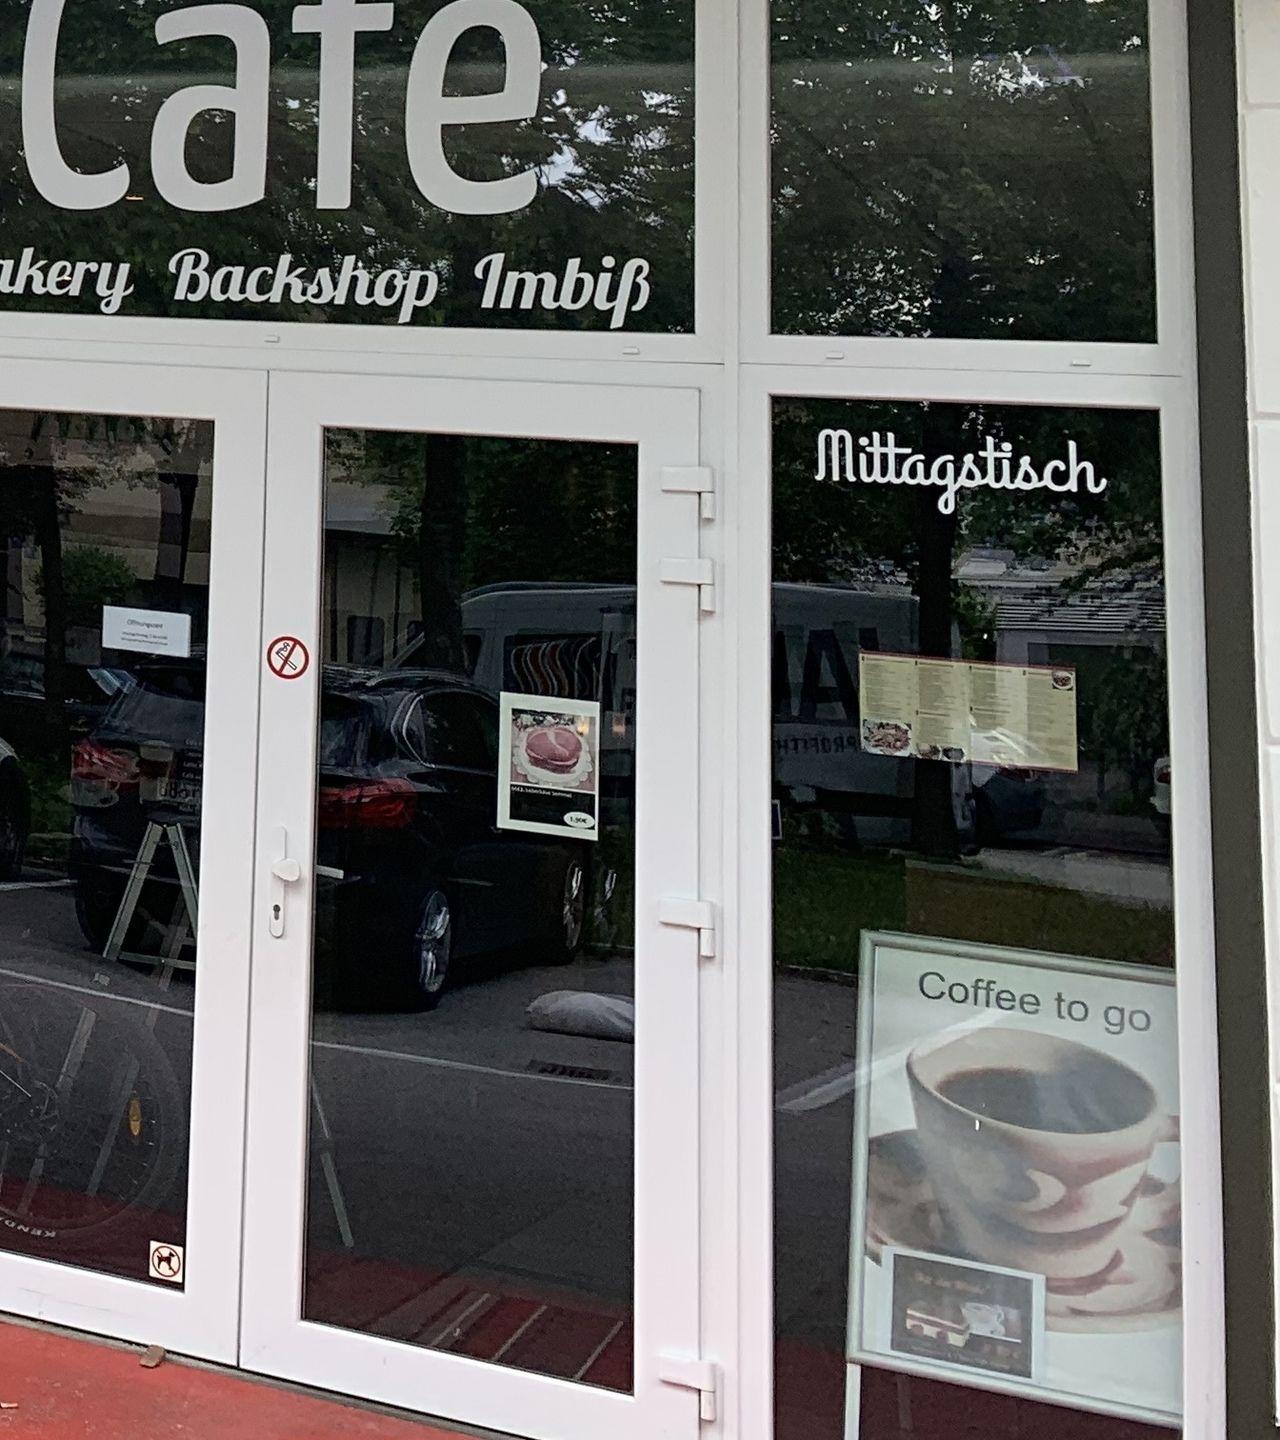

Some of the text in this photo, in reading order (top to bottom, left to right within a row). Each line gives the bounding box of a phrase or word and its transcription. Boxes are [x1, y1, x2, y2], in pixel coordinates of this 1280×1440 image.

[168, 247, 440, 324] Backshop
[474, 251, 651, 330] Imbiß
[815, 428, 1108, 515] Mittagstisch
[918, 971, 1152, 1035] Coffee to go
